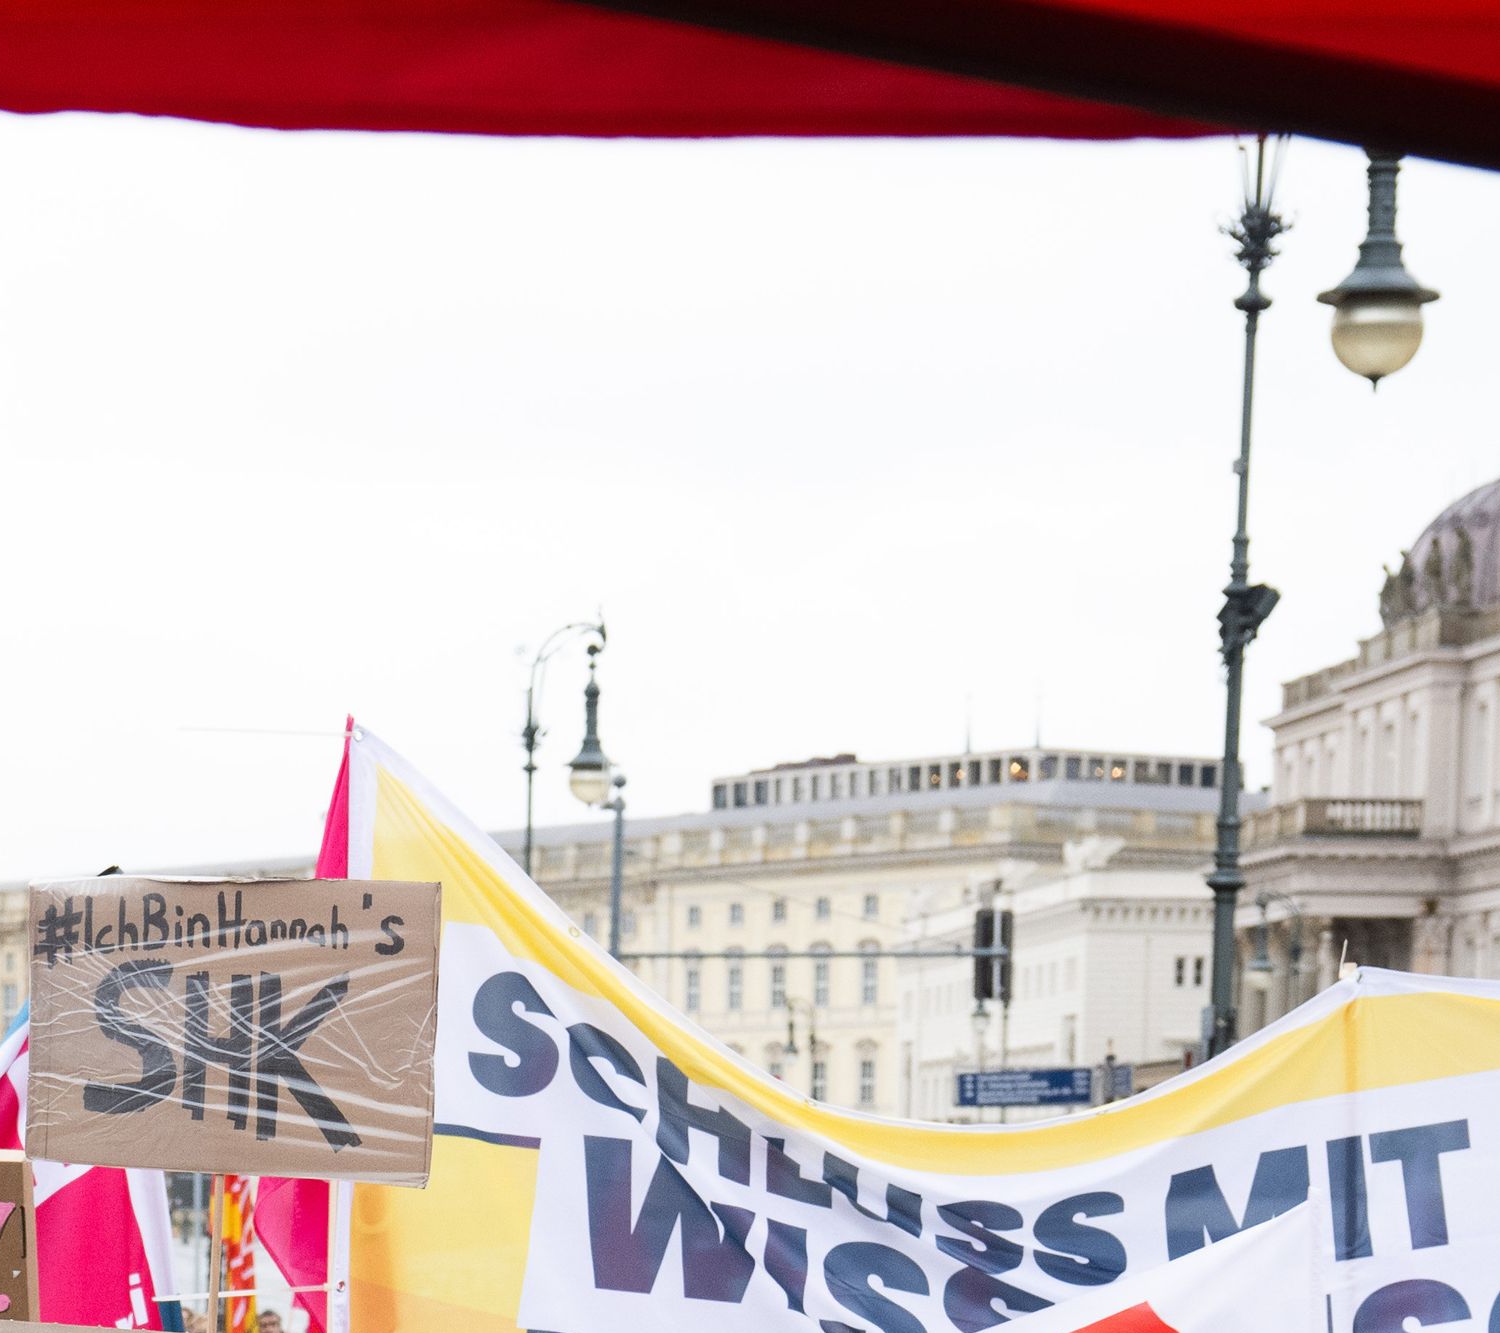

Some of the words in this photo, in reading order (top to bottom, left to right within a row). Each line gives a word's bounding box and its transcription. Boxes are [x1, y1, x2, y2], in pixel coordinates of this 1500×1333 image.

[82, 957, 363, 1154] SHK
[468, 969, 1126, 1286] SCHLUSS
[1165, 1120, 1468, 1261] MIT
